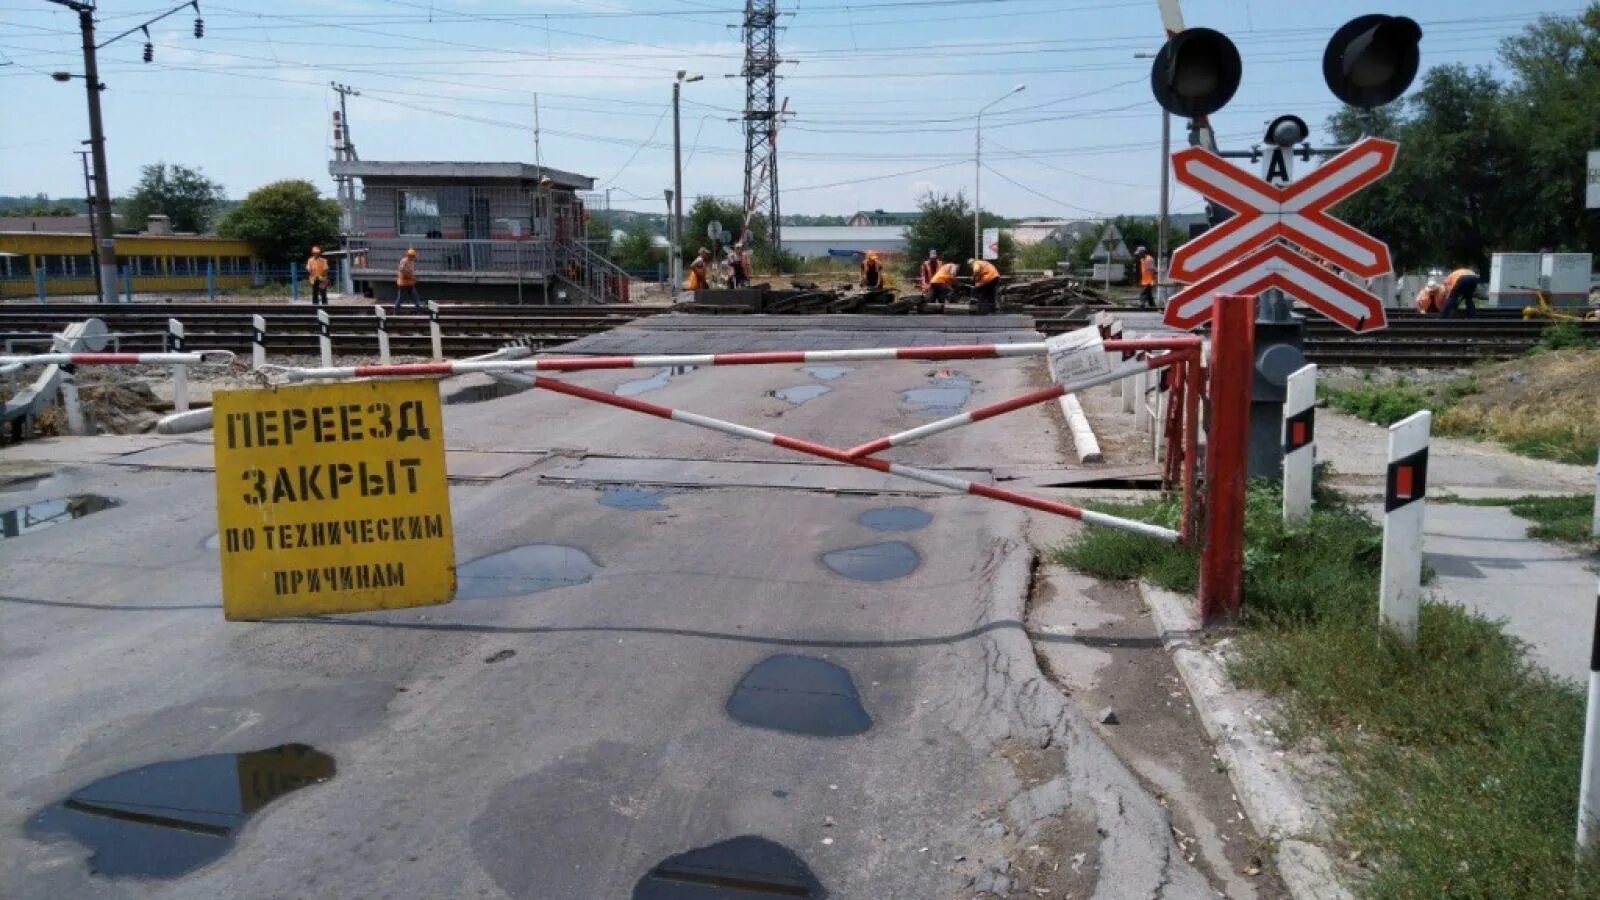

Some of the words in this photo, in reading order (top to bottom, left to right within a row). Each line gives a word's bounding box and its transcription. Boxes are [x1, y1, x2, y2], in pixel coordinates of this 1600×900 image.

[1266, 148, 1289, 183] А
[226, 400, 431, 449] ПЕРЕЕЗД
[242, 458, 421, 505] ЗАКРЫТ
[226, 528, 255, 553] ПО
[263, 514, 444, 551] ТЕХНИЧЕСКИМ
[273, 562, 406, 596] ПРИЧИНАМ
